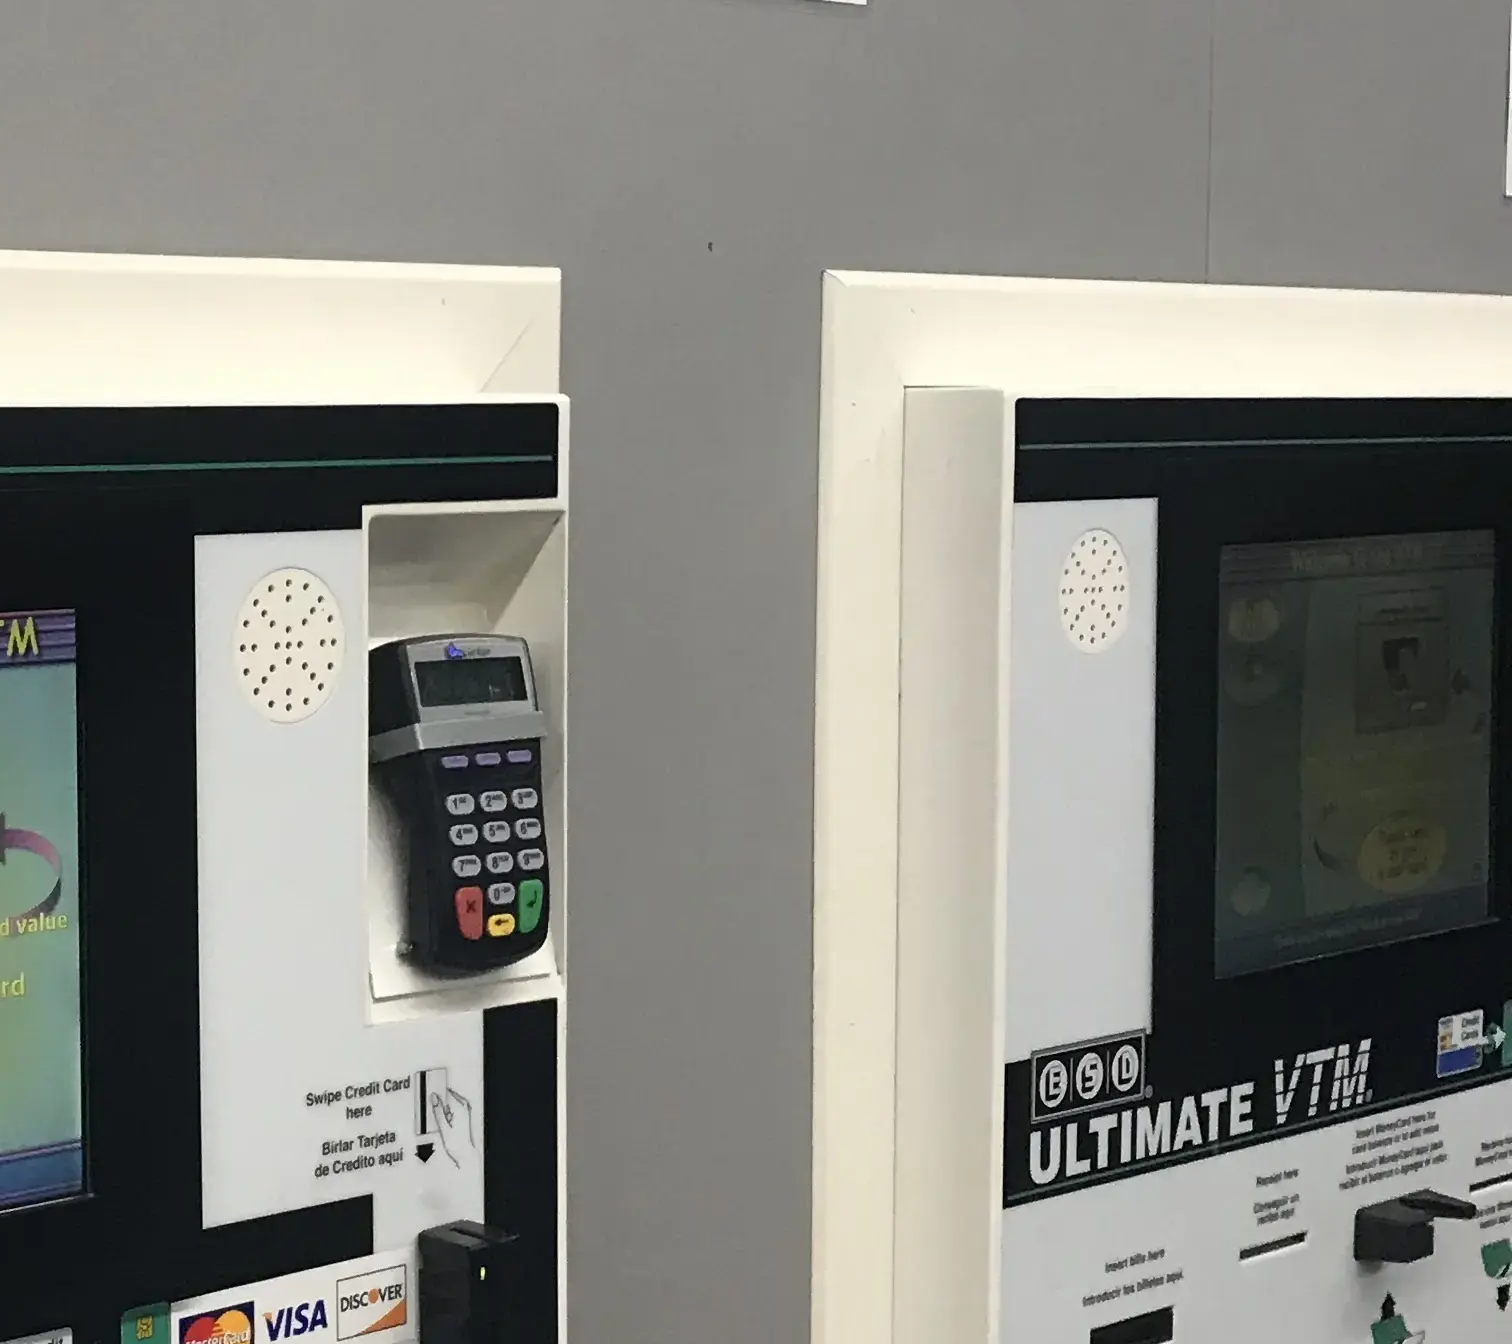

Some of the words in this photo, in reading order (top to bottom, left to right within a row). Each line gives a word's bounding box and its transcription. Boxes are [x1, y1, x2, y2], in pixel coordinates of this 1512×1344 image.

[17, 913, 67, 933] value
[306, 1091, 342, 1106] Swipe
[345, 1082, 380, 1099] Credit
[384, 1076, 410, 1092] Card
[346, 1106, 372, 1119] here
[1030, 1082, 1253, 1183] ULTIMATE
[1275, 1039, 1372, 1123] VTM
[357, 1131, 395, 1149] Tarjeta
[315, 1164, 329, 1177] de
[333, 1156, 375, 1174] Credito
[265, 1300, 328, 1341] VISA
